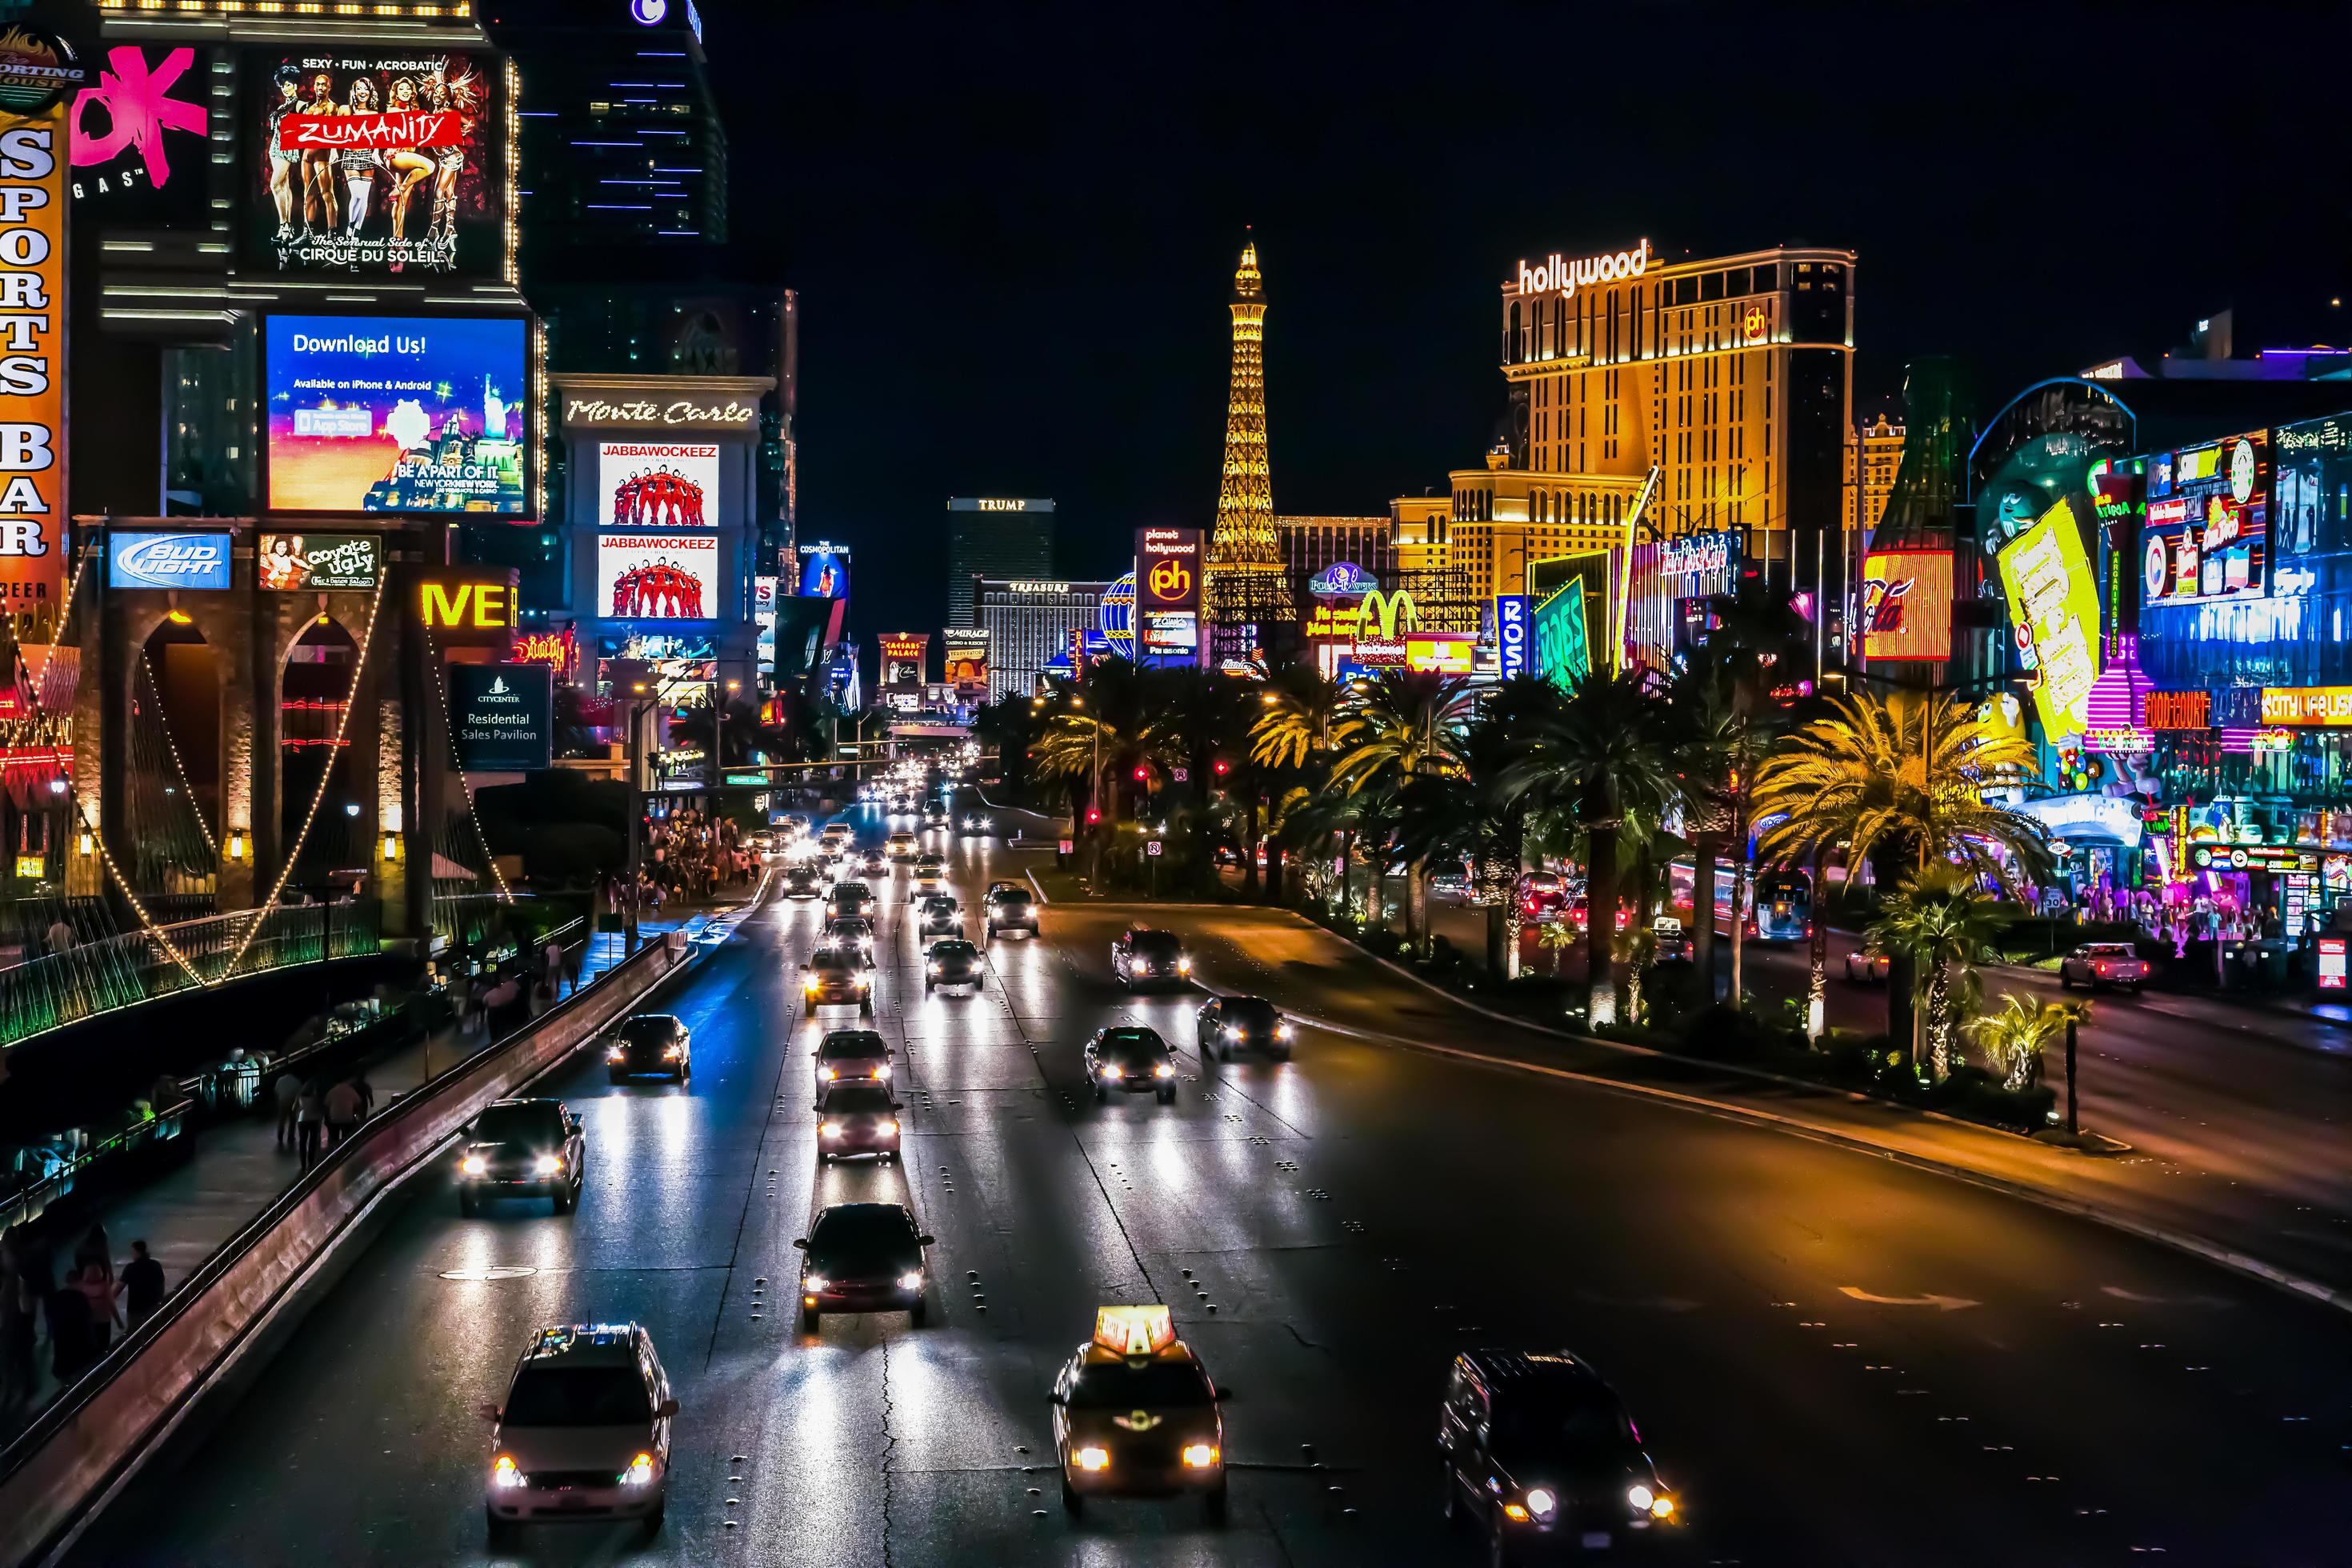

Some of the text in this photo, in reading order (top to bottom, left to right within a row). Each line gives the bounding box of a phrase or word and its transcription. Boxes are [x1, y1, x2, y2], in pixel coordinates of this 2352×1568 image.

[302, 58, 442, 71] SEXY FUN ACROBATIC
[0, 74, 64, 88] OUSE
[312, 235, 429, 251] The Sensual Side of
[0, 128, 54, 396] SPORTS
[299, 247, 358, 265] CIRQUE
[362, 250, 384, 262] DU
[1519, 238, 1647, 299] hollywood
[294, 334, 426, 354] Download Us!
[294, 379, 431, 391] Available on iPhone & Android
[567, 400, 753, 423] Monte Carlo
[314, 420, 368, 433] App Store
[603, 446, 716, 457] JABBAWOCKEEZ
[398, 465, 414, 478] BE
[417, 465, 428, 478] A
[430, 465, 462, 478] PART
[464, 466, 484, 478] OF
[0, 422, 54, 557] BAR
[978, 499, 1026, 510] TRUMP
[1146, 530, 1179, 541] planet
[602, 538, 715, 550] JABBAWOCKEEZ
[800, 546, 848, 554] COSMOPOLITAN
[1146, 542, 1195, 555] hollywood
[147, 545, 218, 560] BUD
[307, 540, 371, 565] coyote
[133, 558, 223, 574] LIGHT
[328, 552, 374, 575] ugly
[1154, 561, 1190, 594] ph
[1010, 582, 1069, 593] TREASURE
[1310, 580, 1378, 590] POLO TOWERS
[953, 630, 990, 638] MIRAGE
[1150, 646, 1189, 654] Panasonic
[2145, 692, 2206, 727] FOOD COURT
[468, 714, 530, 724] Residential
[462, 730, 537, 741] Sales Pavilion
[2266, 860, 2298, 869] SUBWAY
